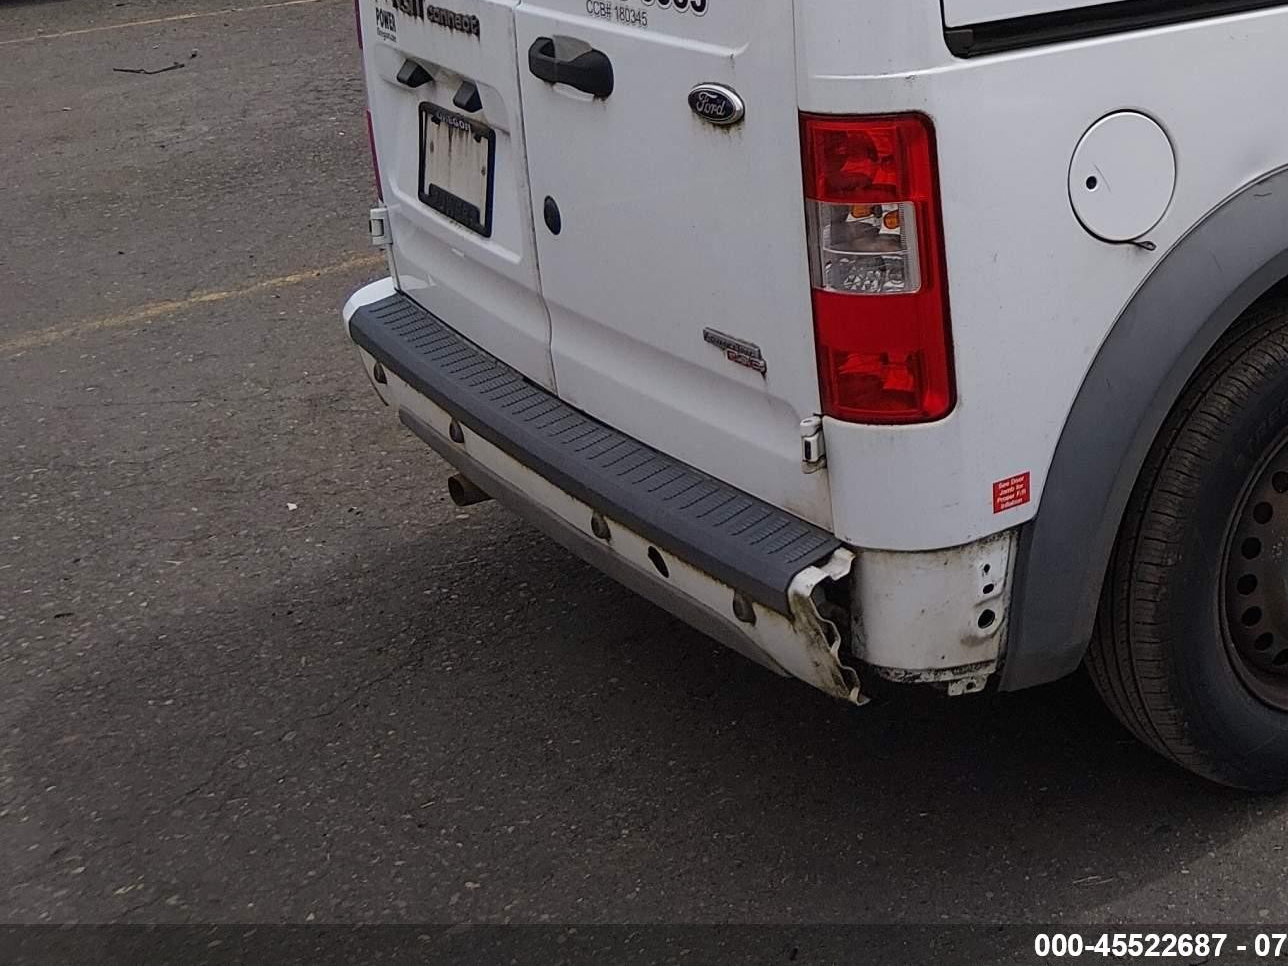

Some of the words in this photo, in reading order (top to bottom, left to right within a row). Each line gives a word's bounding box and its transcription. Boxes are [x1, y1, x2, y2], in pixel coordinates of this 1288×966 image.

[586, 0, 612, 18] CCB#
[614, 7, 648, 27] 180345
[696, 91, 726, 116] Ford
